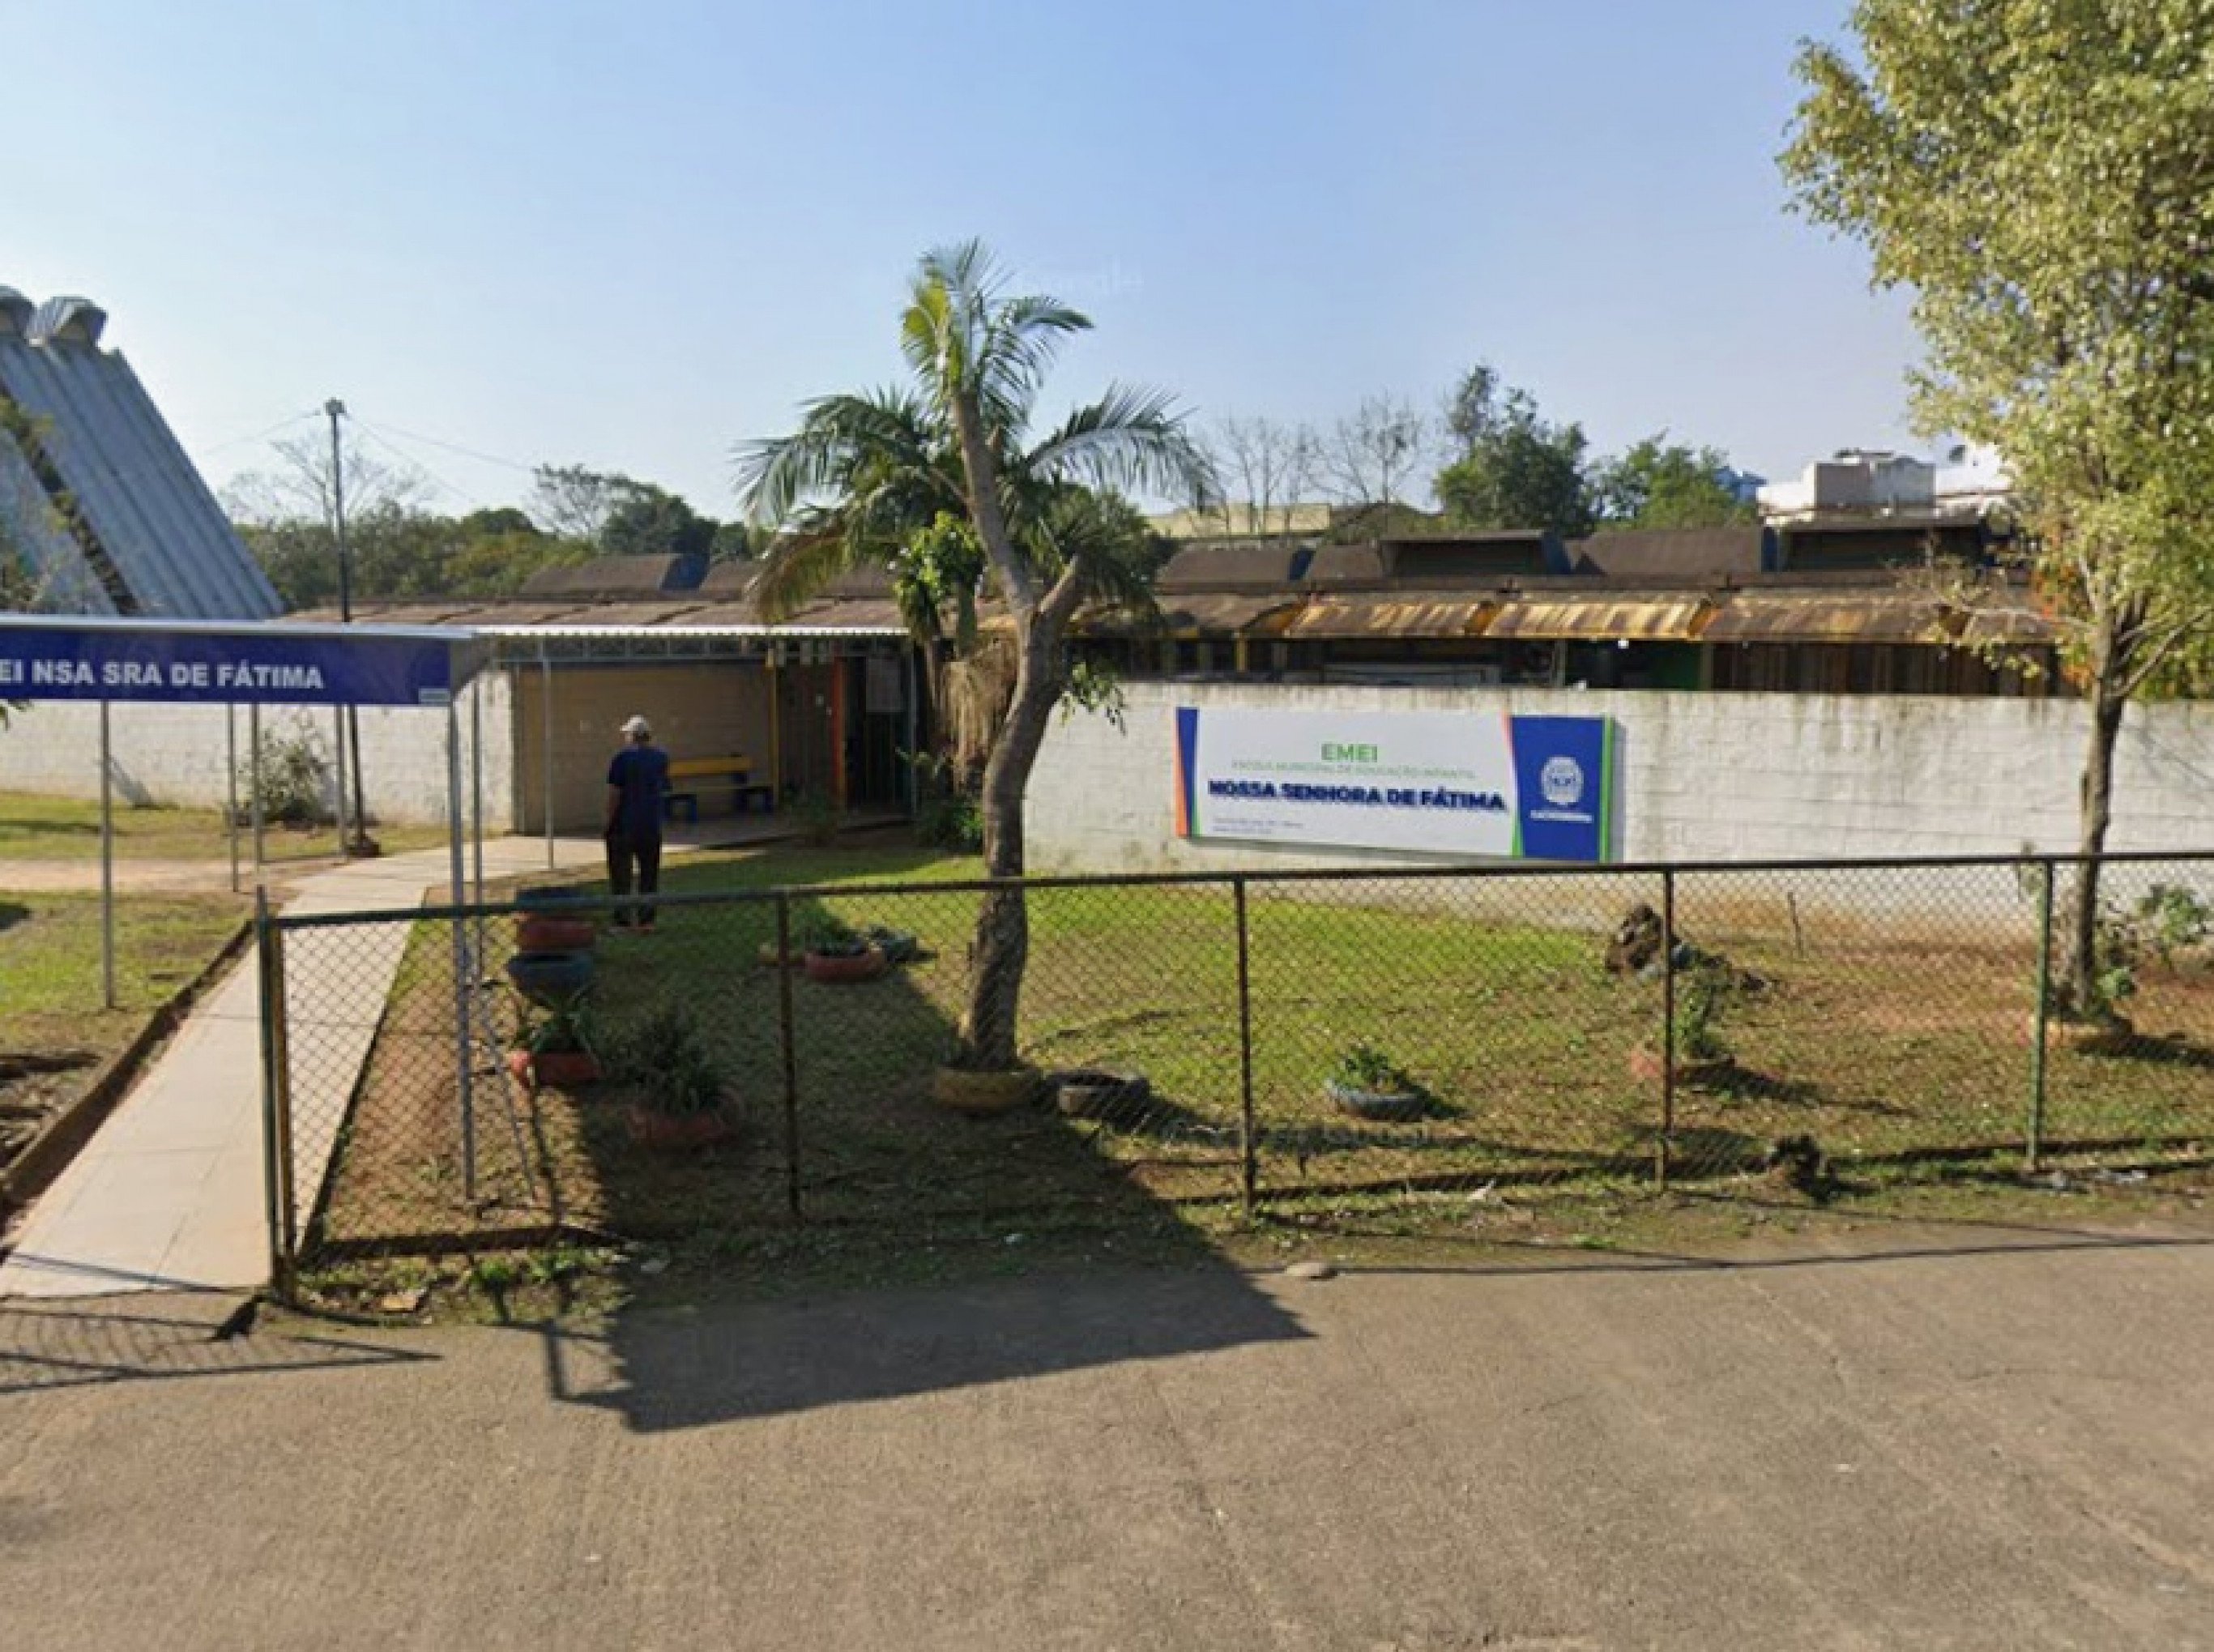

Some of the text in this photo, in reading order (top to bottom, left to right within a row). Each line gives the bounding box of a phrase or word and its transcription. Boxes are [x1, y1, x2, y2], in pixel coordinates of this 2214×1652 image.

[32, 659, 95, 685] NSA
[102, 661, 162, 687] SRA
[169, 663, 209, 688] DE
[216, 659, 325, 689] FÁTIMA
[1321, 743, 1378, 762] EMEI
[1208, 779, 1508, 812] NOSSA SENHORA DE FÁTIMA
